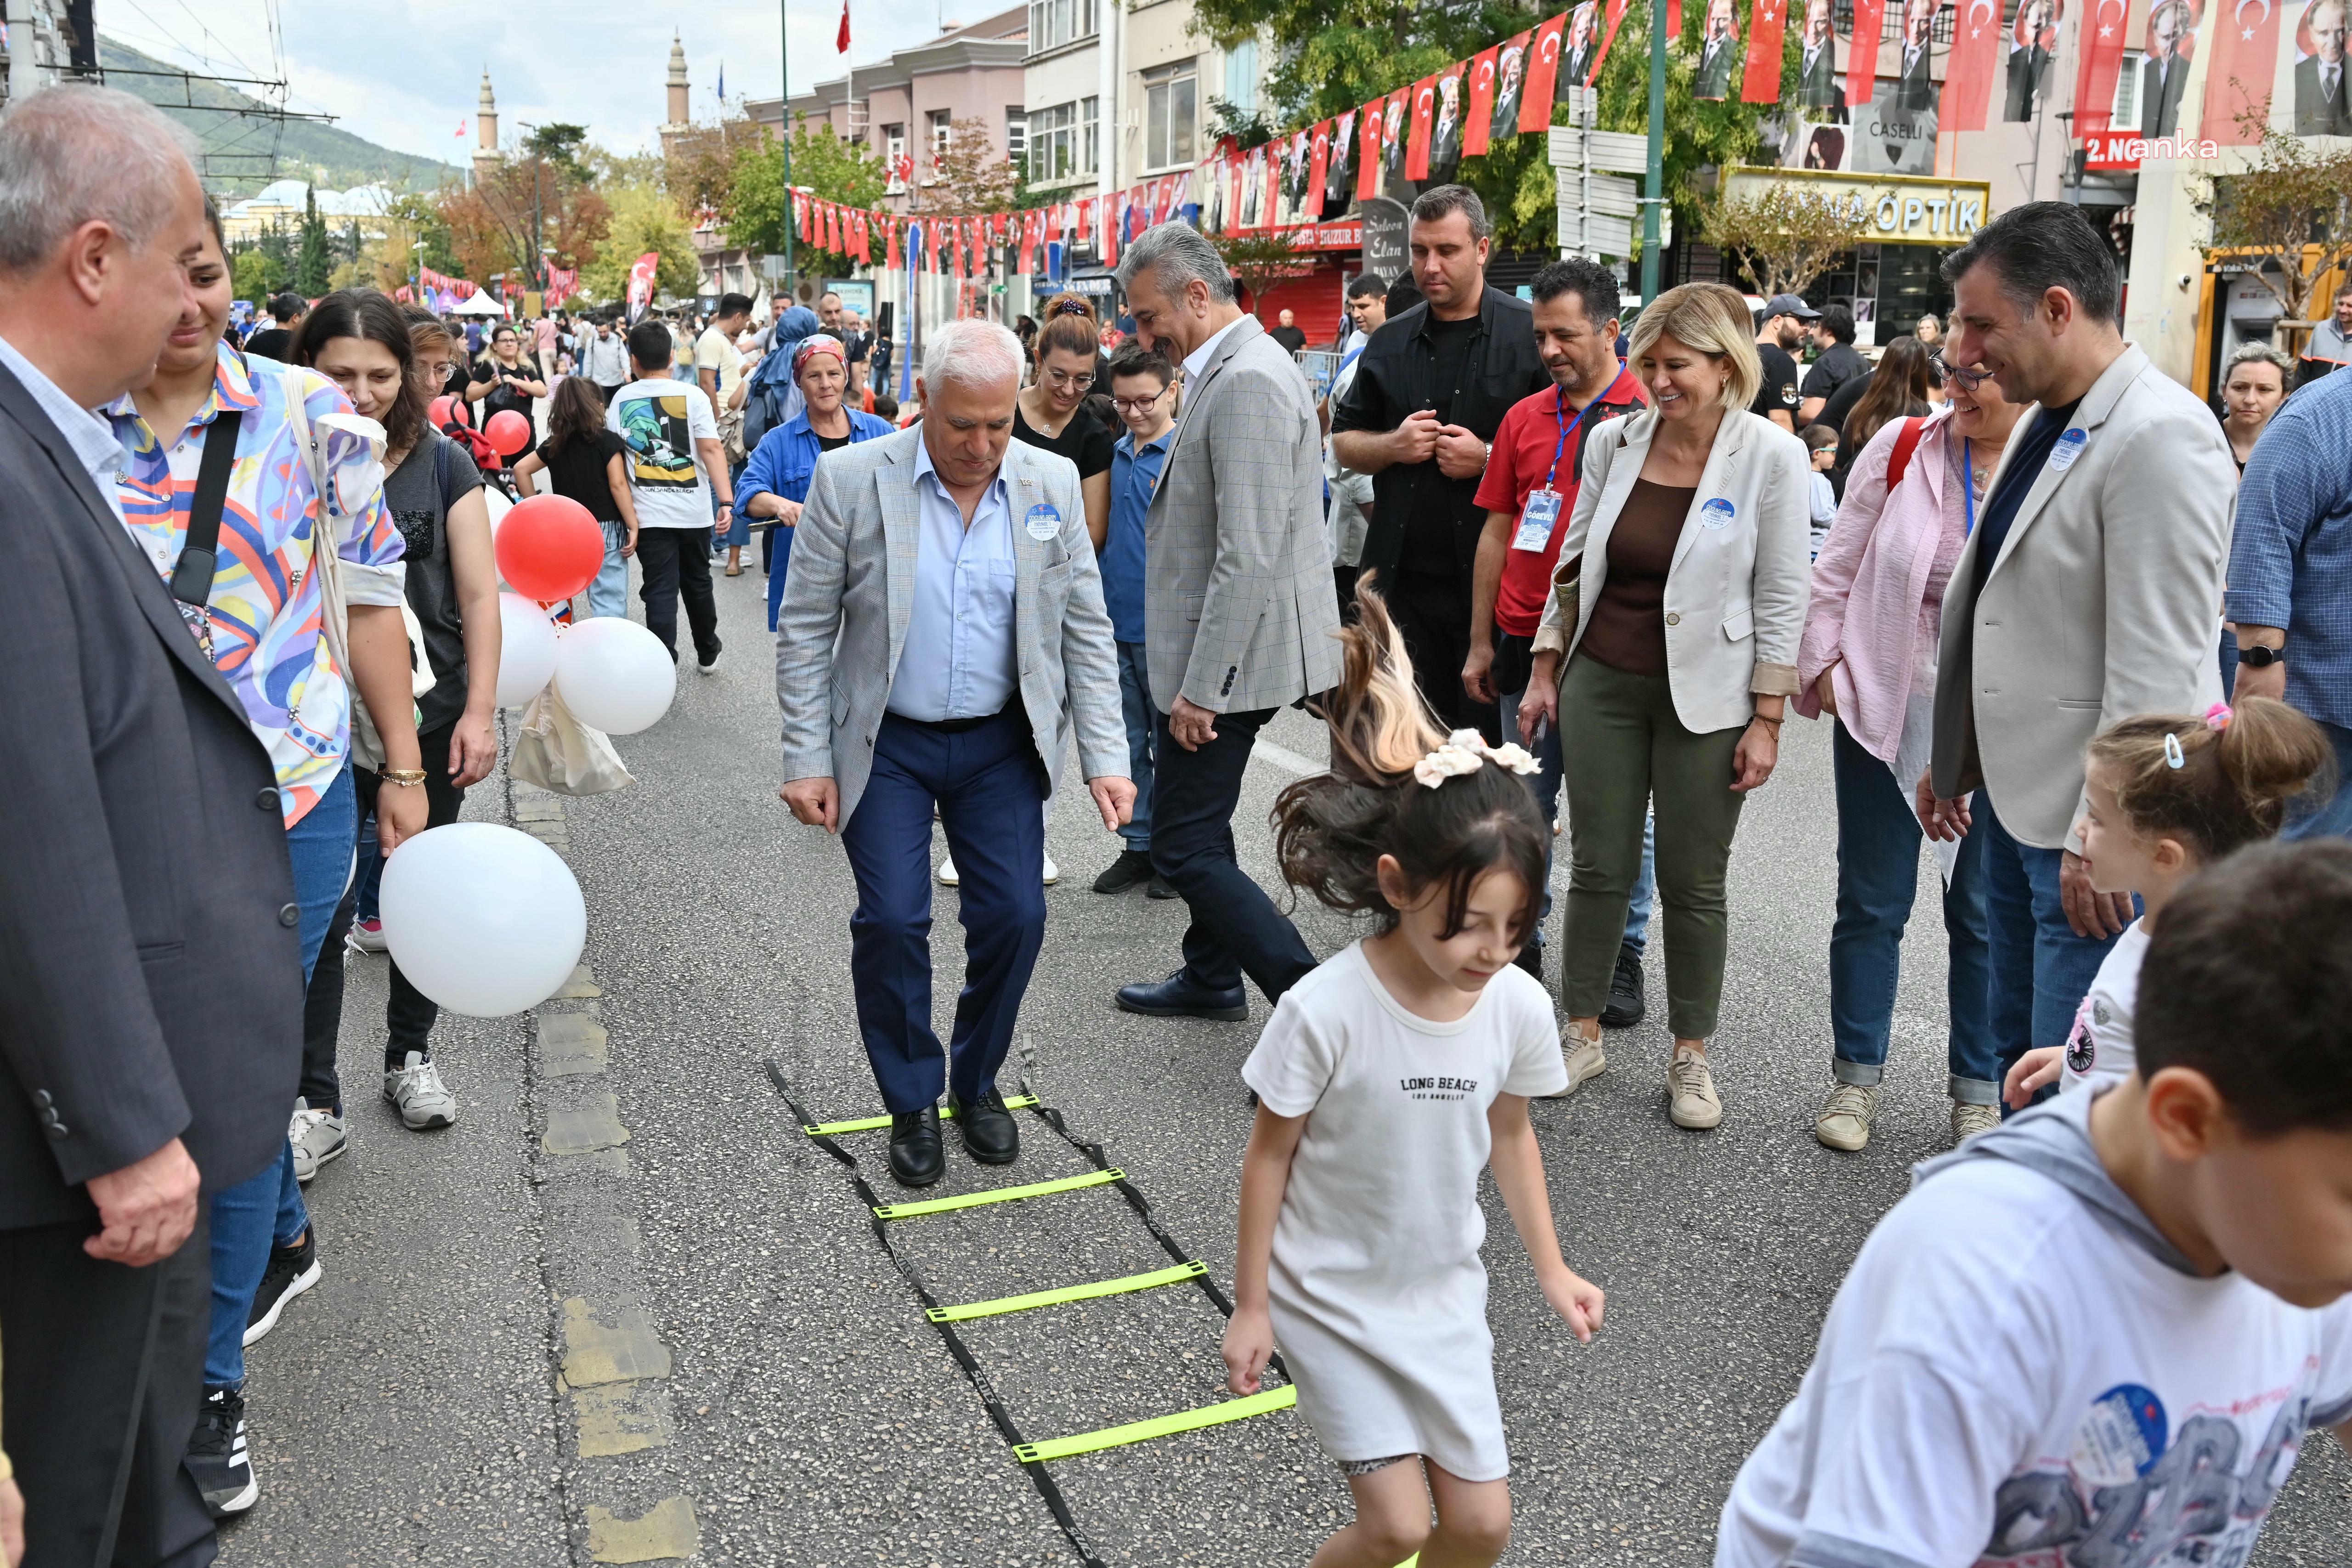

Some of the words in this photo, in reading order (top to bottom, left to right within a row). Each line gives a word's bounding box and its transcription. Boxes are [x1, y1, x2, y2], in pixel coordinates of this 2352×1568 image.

[1870, 121, 1922, 139] CASELLI
[1877, 188, 1979, 233] OPTİK
[1370, 237, 1402, 258] Elan
[1400, 1077, 1434, 1091] LONG
[1438, 1077, 1477, 1093] BEACH
